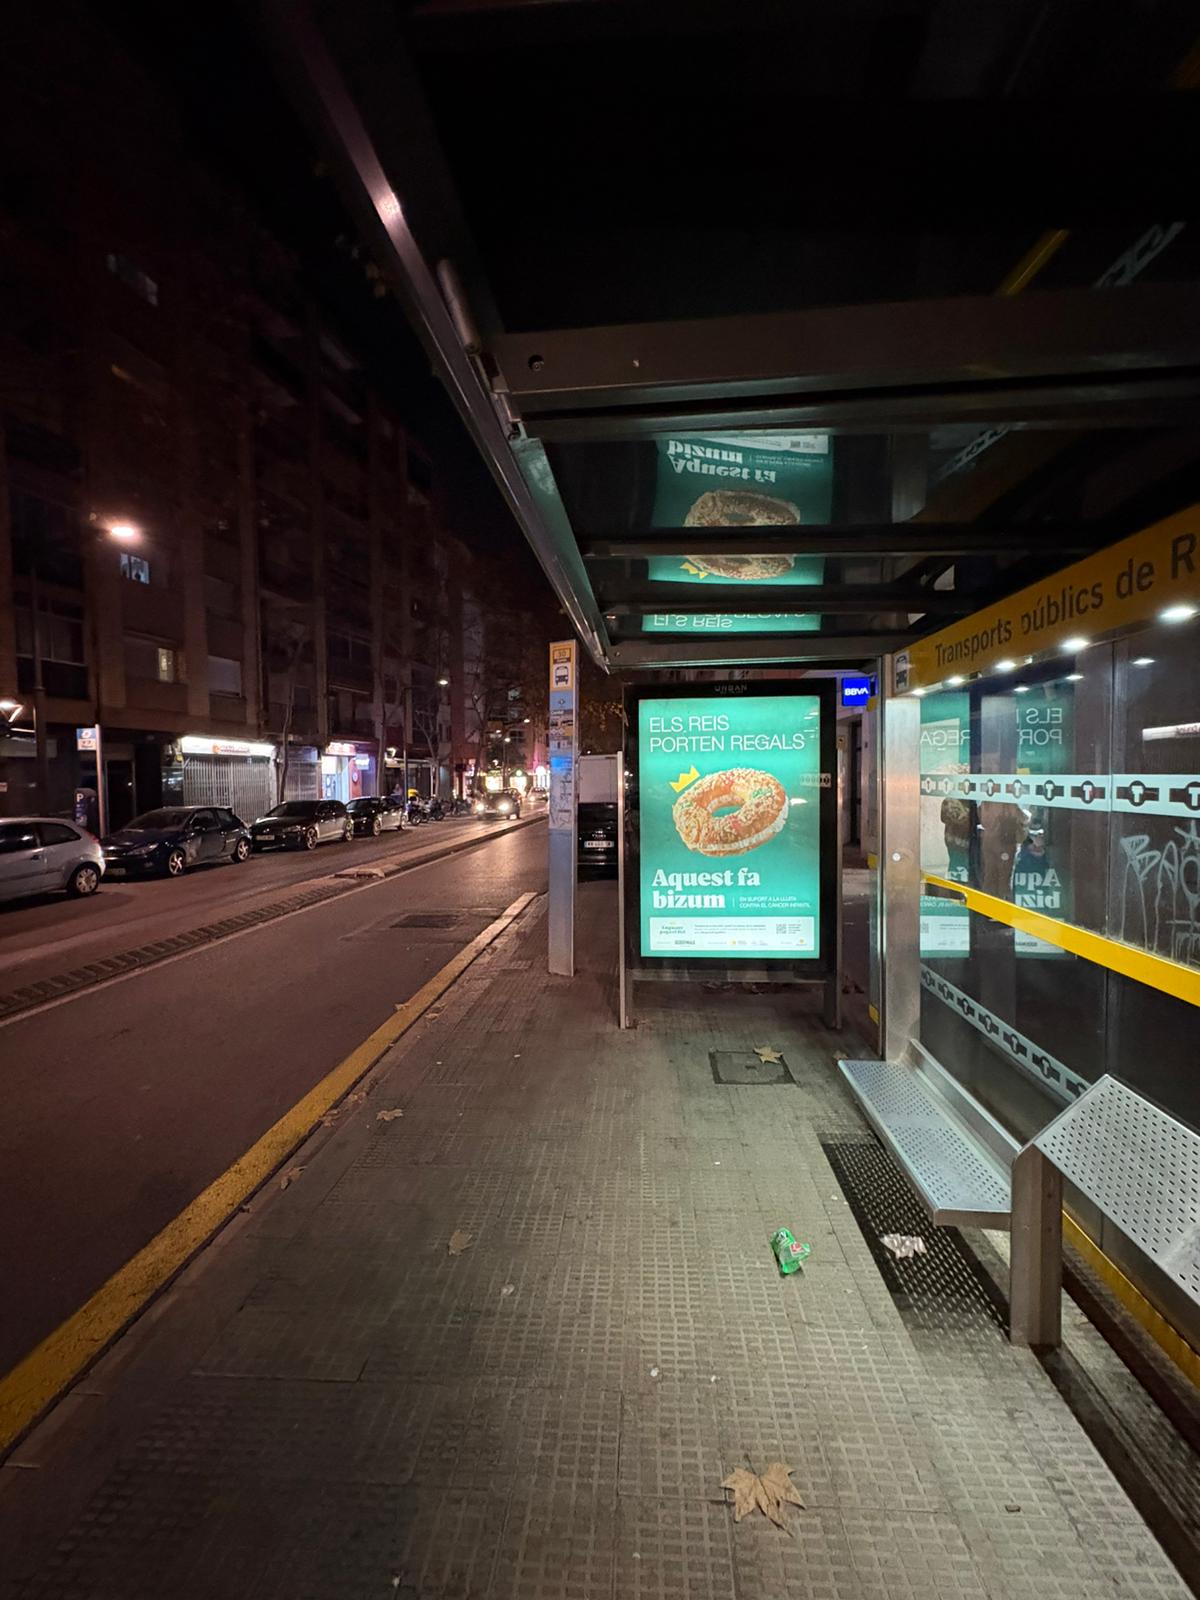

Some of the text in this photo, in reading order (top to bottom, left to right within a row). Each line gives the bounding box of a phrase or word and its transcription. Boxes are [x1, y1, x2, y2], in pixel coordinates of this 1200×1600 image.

[935, 618, 1013, 668] Transports
[1116, 557, 1155, 599] de
[1171, 532, 1197, 579] R
[844, 687, 869, 696] BBVA
[649, 715, 730, 733] ELS REIS
[649, 733, 806, 753] PORTEN REGALS
[651, 867, 761, 892] Aquest fa
[653, 890, 726, 909] bizum
